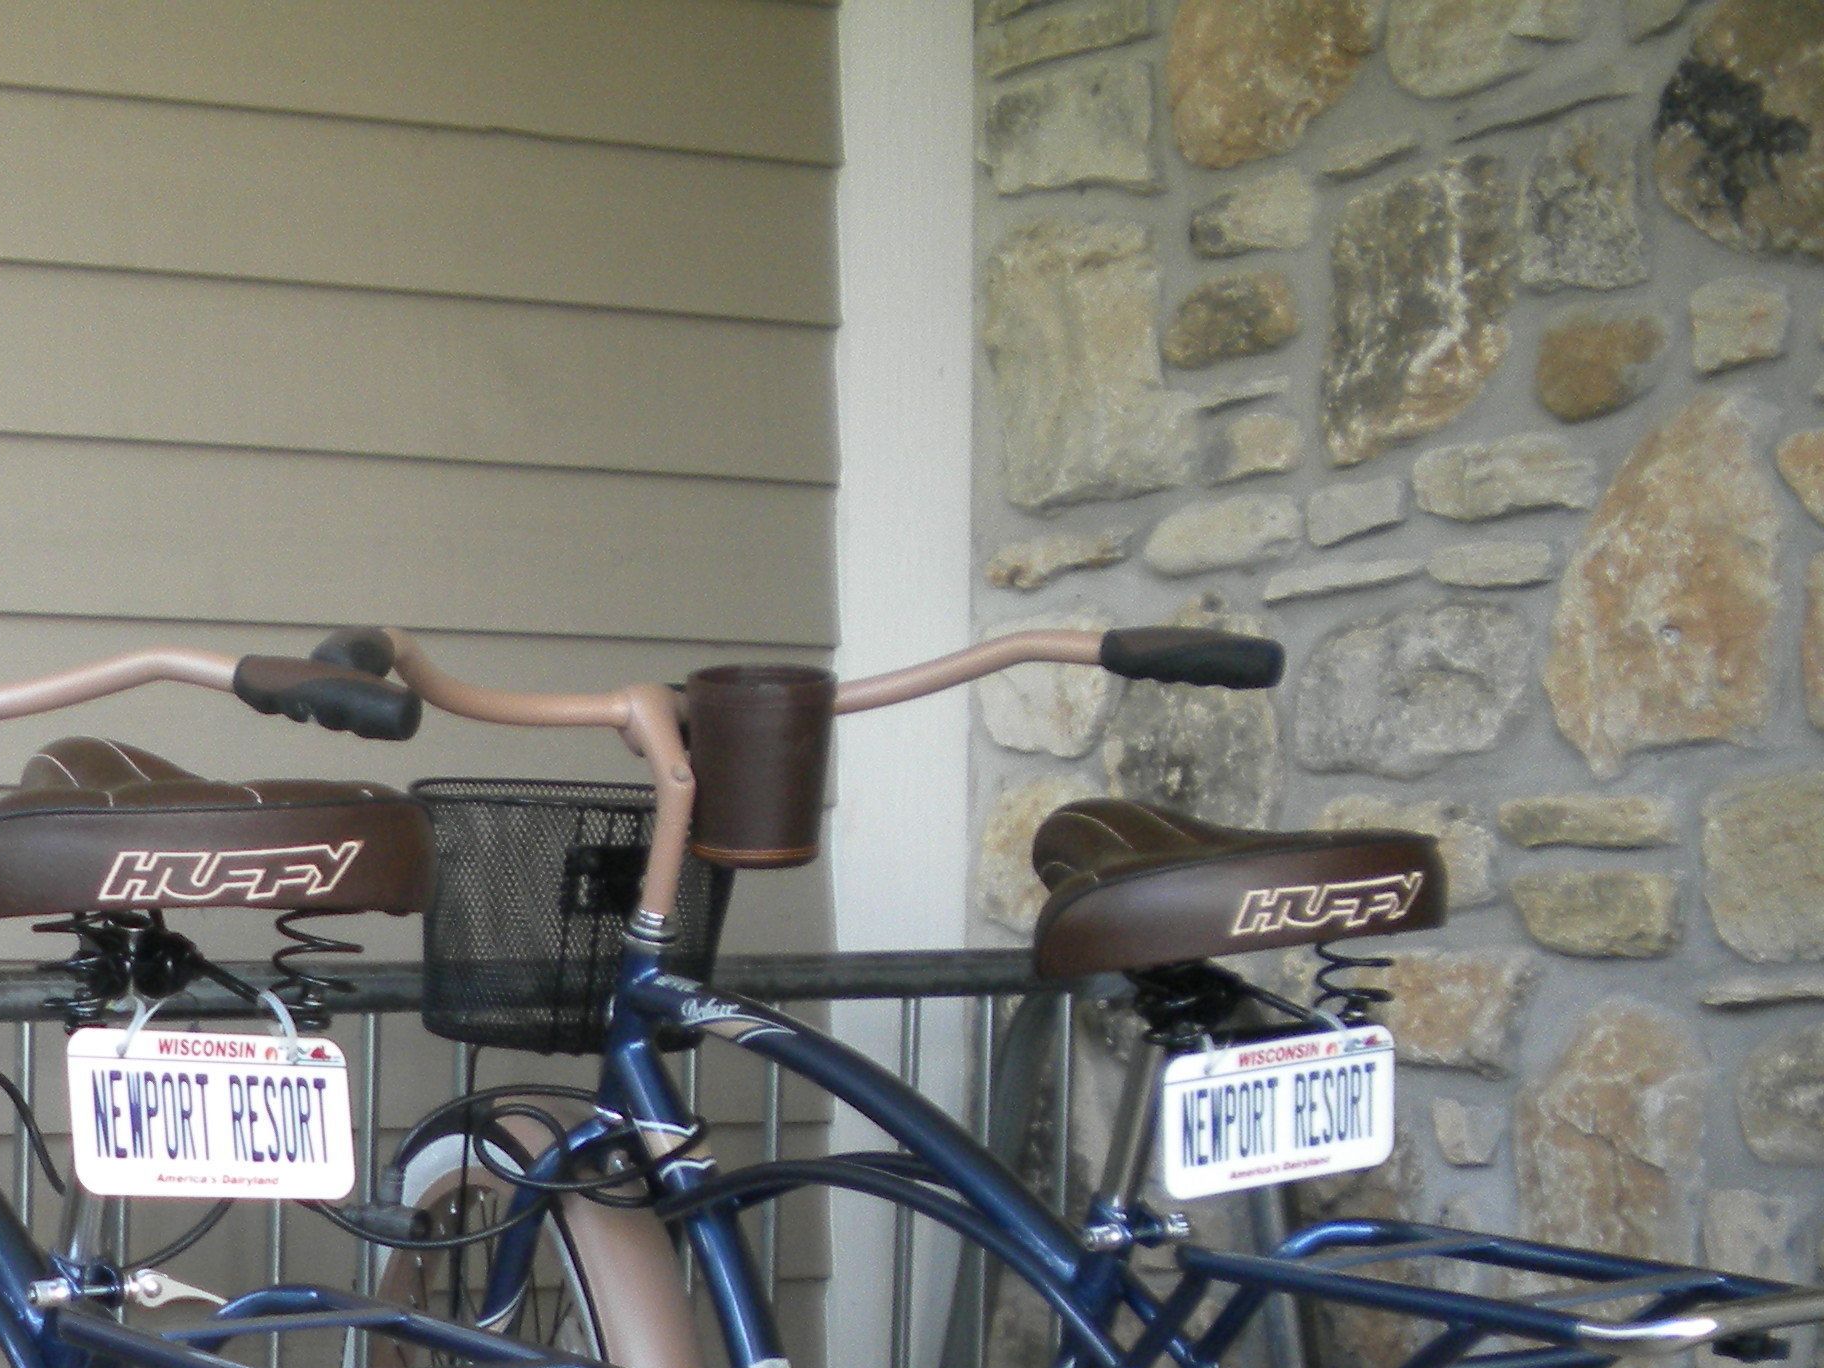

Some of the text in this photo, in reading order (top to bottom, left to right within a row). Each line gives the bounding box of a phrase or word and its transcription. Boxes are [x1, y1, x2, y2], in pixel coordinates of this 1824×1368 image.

[97, 839, 365, 901] HUFFY
[1231, 871, 1424, 936] HUFFY
[158, 1038, 256, 1059] WISCONSIN
[1238, 1042, 1320, 1068] WISCONSIN
[91, 1069, 328, 1163] NEWPORT RESORT
[1182, 1062, 1376, 1168] NEWPORT RESORT
[221, 1173, 279, 1187] Dairyland
